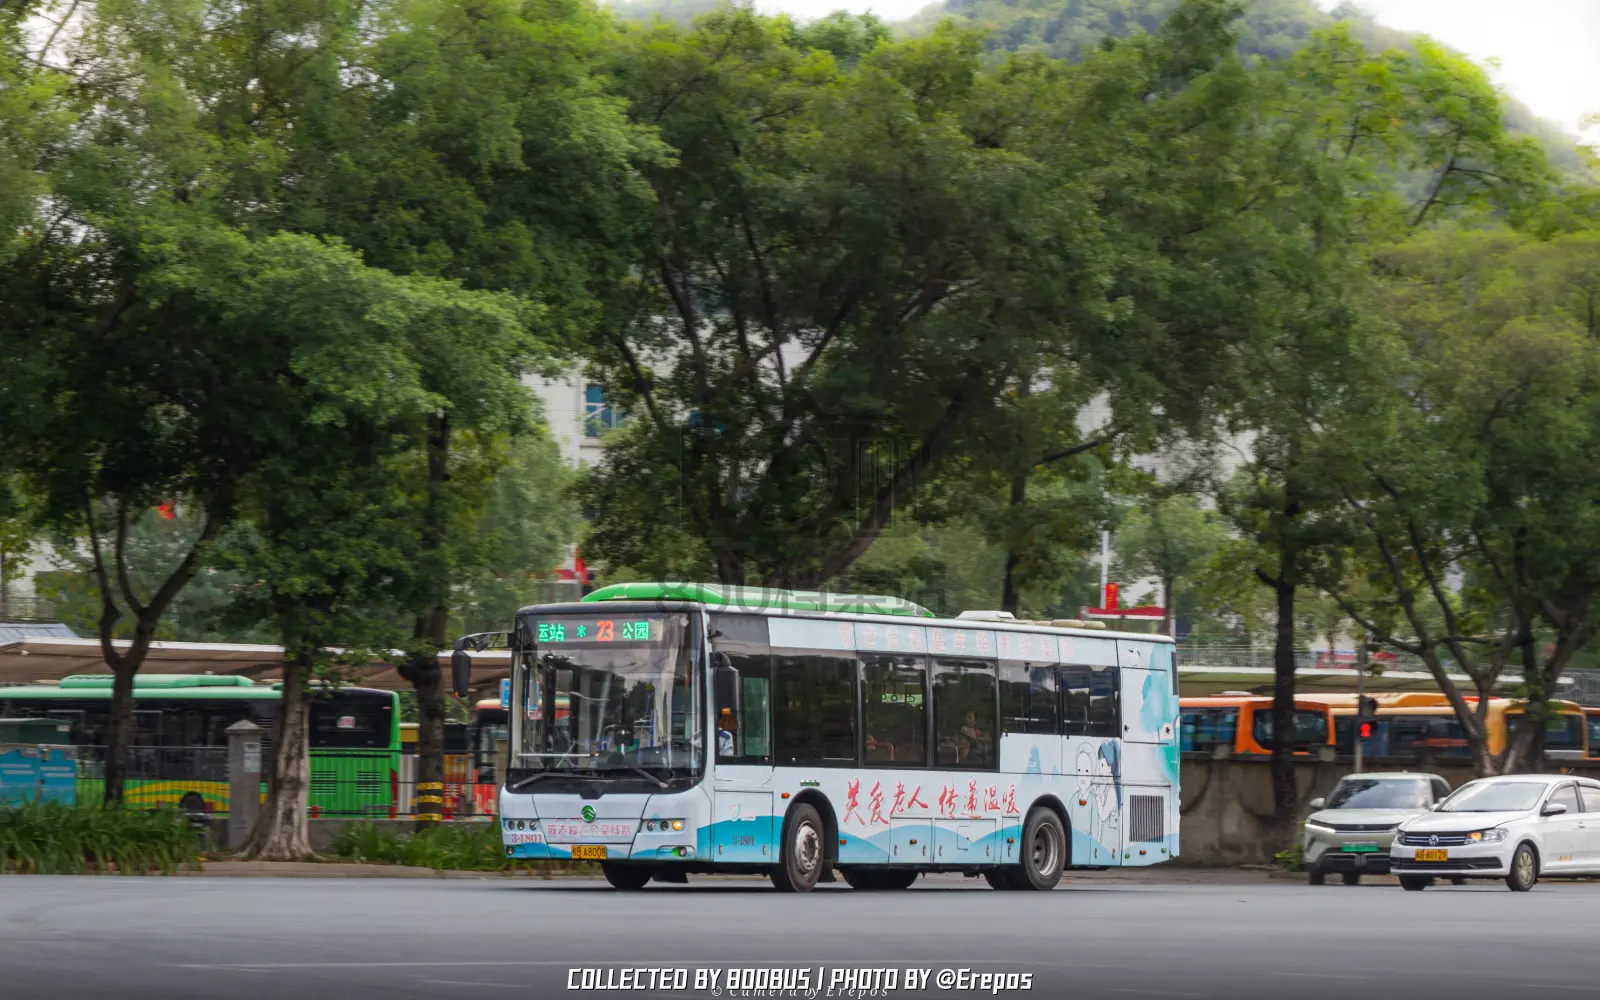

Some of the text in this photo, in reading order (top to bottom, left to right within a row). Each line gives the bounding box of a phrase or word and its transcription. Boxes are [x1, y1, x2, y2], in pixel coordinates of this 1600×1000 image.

[595, 619, 614, 641] 23
[622, 621, 649, 640] 公园
[938, 777, 1021, 820] 传递温暖
[511, 833, 543, 844] 3-1801
